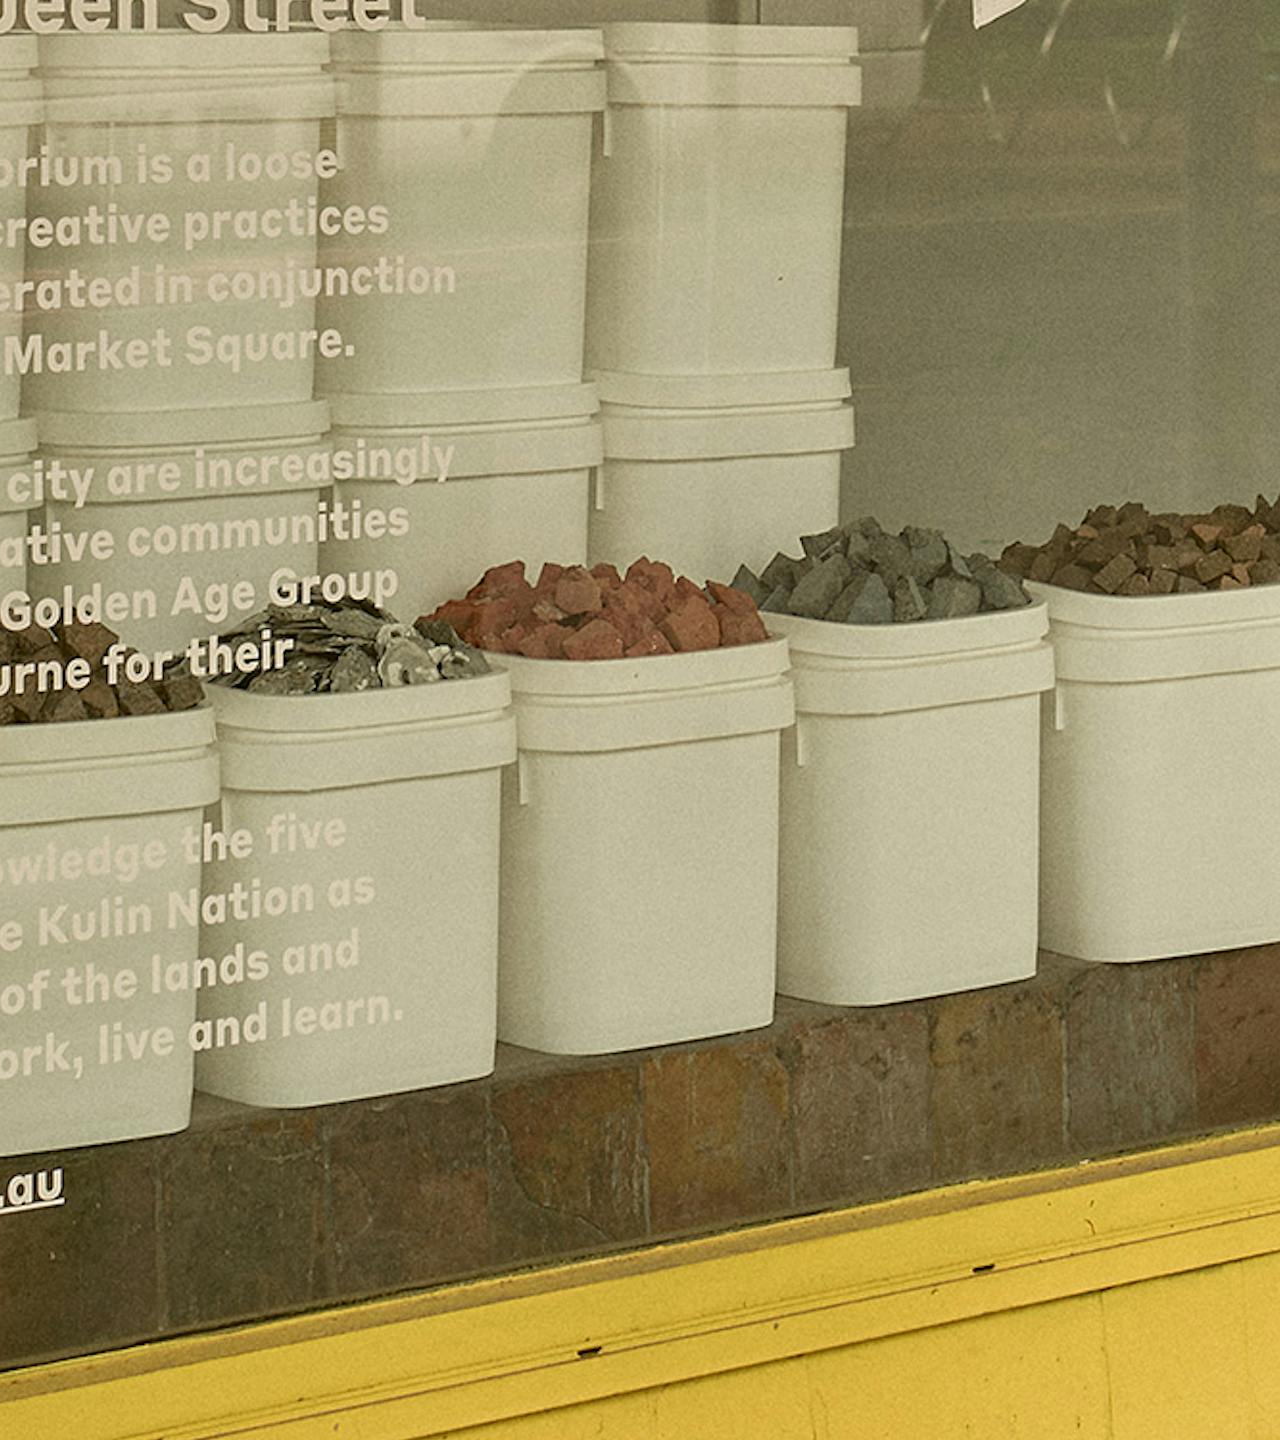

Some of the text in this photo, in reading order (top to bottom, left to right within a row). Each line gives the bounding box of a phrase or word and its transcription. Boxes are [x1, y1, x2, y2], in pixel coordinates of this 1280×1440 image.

[137, 143, 174, 184] is
[185, 149, 211, 183] a
[224, 142, 341, 183] loose
[184, 197, 390, 251] practices
[153, 265, 193, 305] in
[206, 254, 457, 308] conjunction
[3, 328, 172, 377] Market
[185, 321, 357, 372] Square.
[6, 458, 95, 508] city
[107, 458, 182, 496] are
[193, 434, 455, 492] increasingly
[126, 499, 411, 558] communities
[0, 581, 157, 631] Golden
[170, 576, 257, 623] Age
[268, 565, 400, 609] Group
[101, 642, 175, 687] for
[185, 627, 295, 679] their
[180, 821, 254, 865] the
[265, 812, 348, 856] five
[37, 893, 152, 948] Kulin
[166, 877, 315, 931] Nation
[327, 874, 377, 907] as
[0, 968, 51, 1014] of
[60, 960, 139, 1008] the
[151, 942, 270, 995] lands
[281, 927, 361, 976] and
[98, 1022, 175, 1065] live
[187, 1000, 269, 1053] and
[281, 992, 405, 1039] learn.
